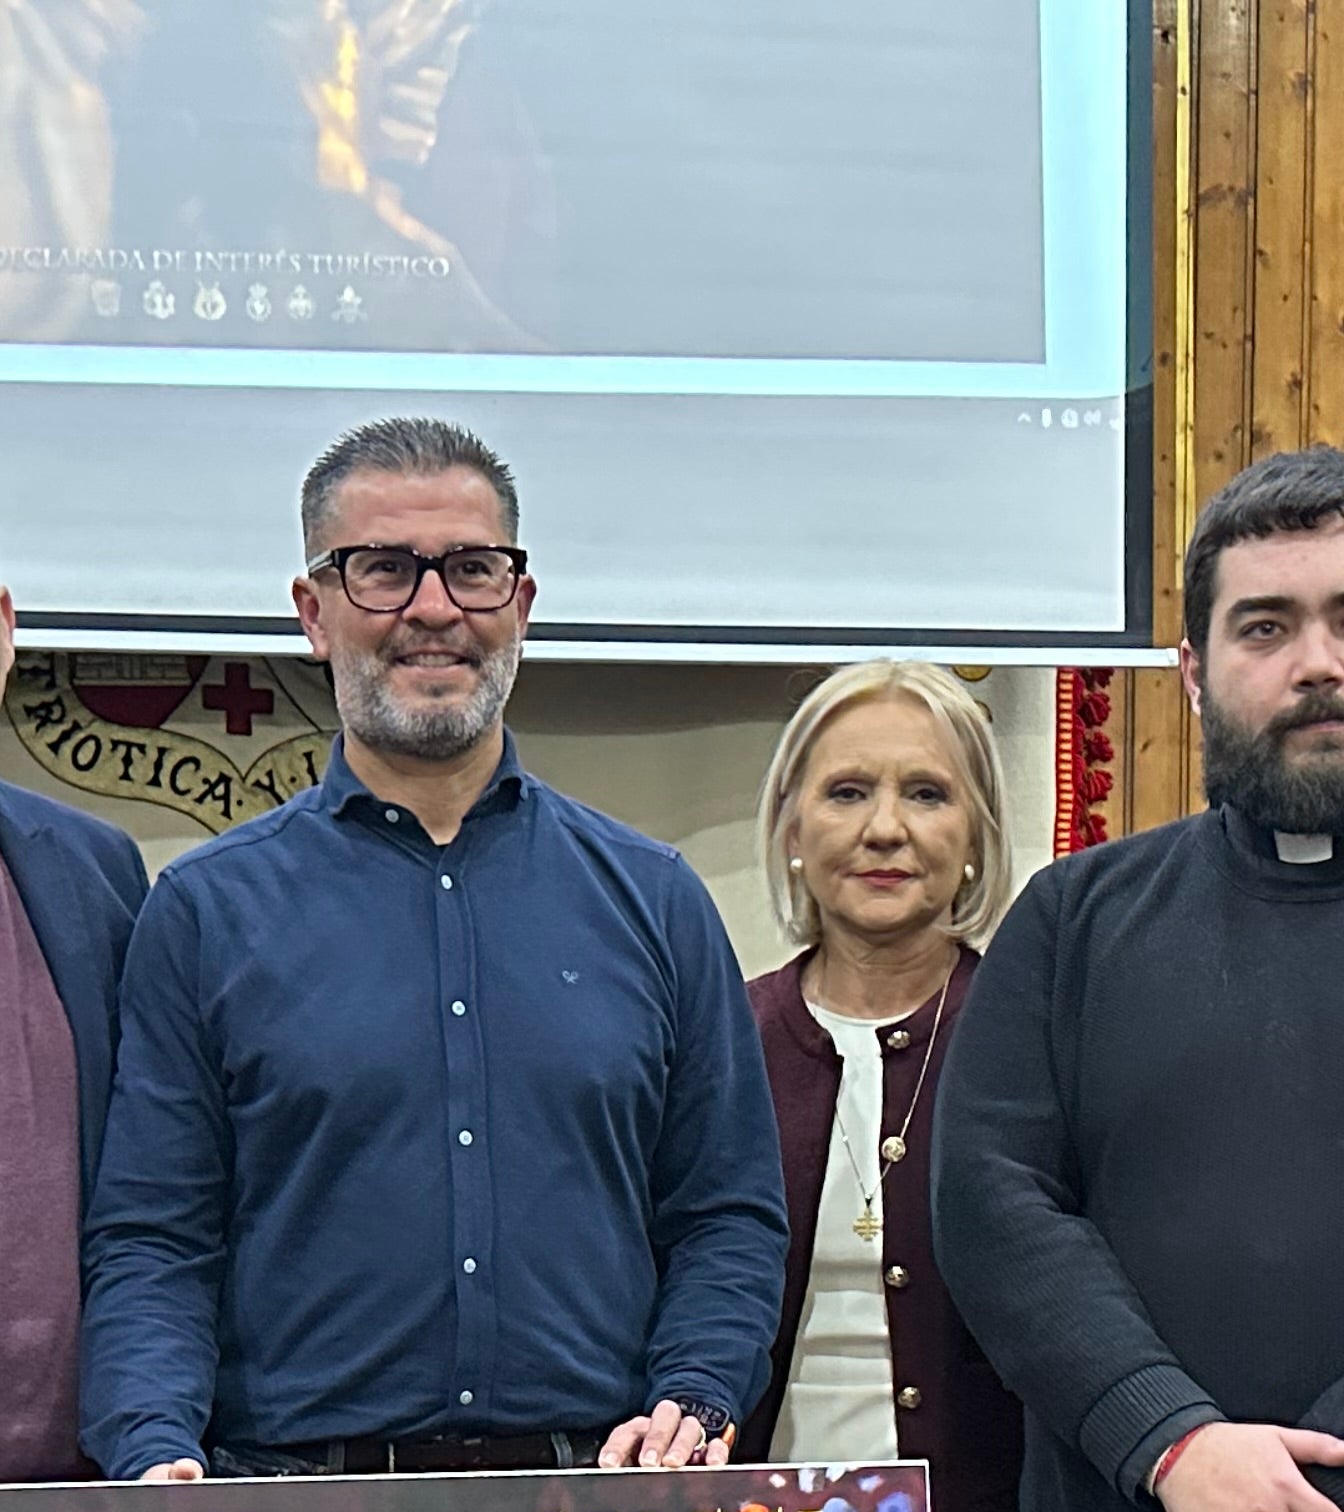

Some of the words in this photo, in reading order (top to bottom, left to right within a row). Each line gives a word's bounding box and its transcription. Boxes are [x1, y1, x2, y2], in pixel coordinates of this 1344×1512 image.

[153, 249, 187, 273] DE
[194, 247, 301, 275] INTERÉS
[307, 250, 450, 278] TURÍSTICO
